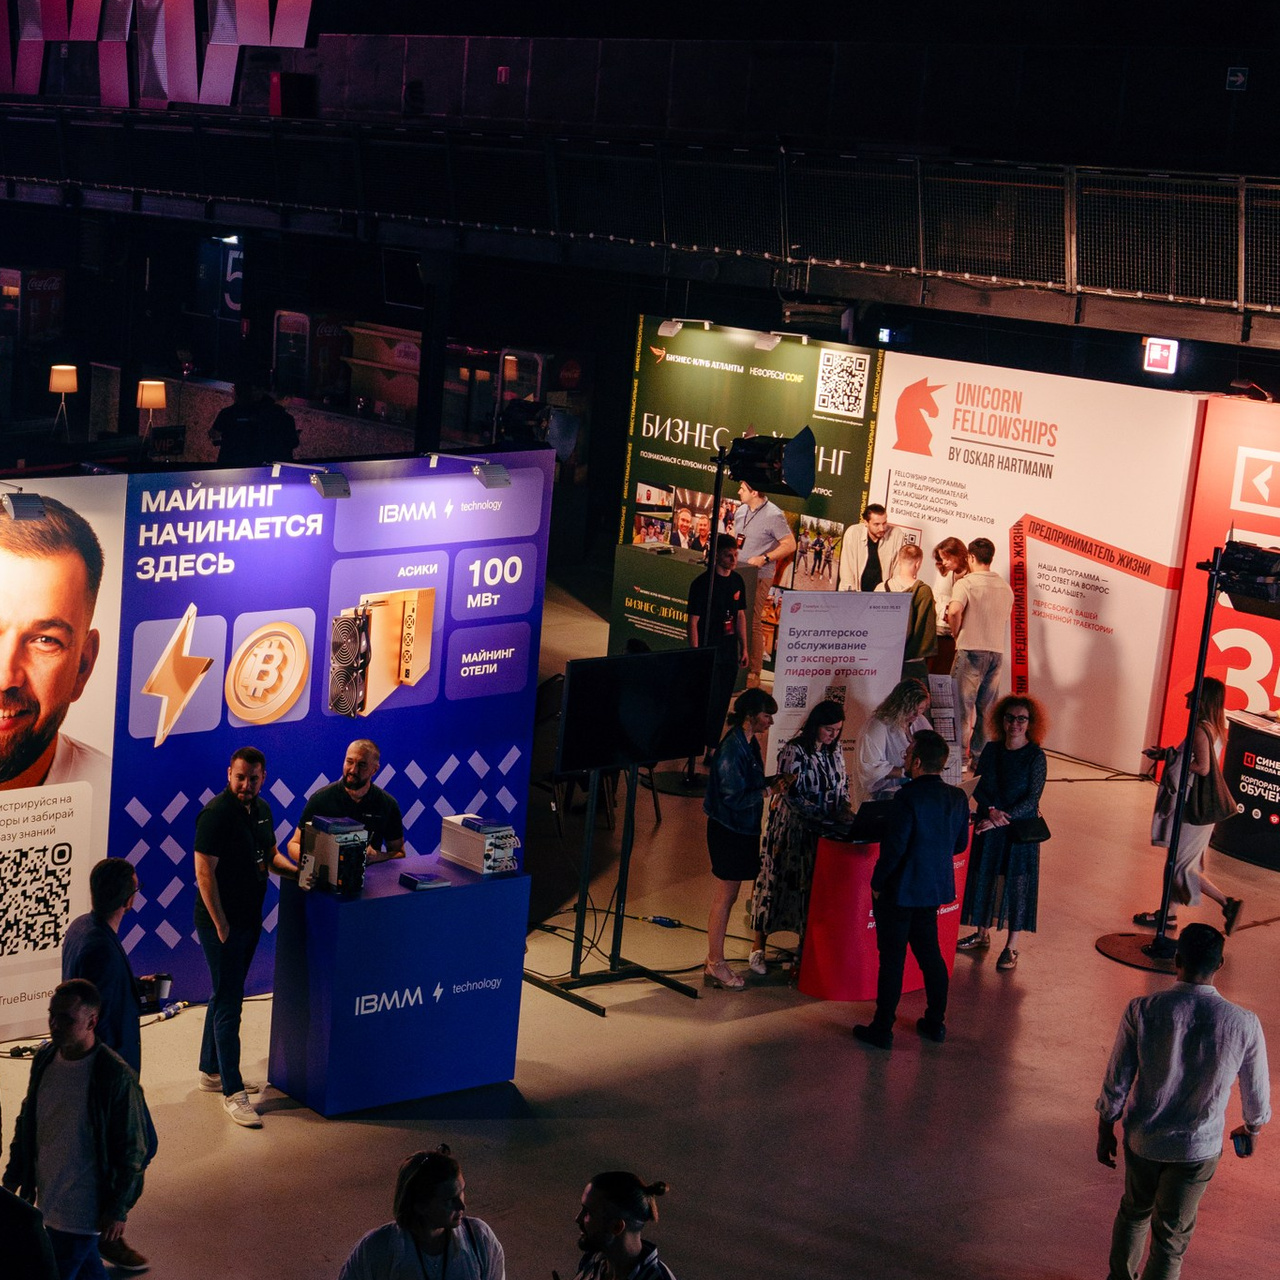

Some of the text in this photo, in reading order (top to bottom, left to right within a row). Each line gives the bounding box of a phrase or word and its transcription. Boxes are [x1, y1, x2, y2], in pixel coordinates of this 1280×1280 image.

[712, 361, 745, 374] АТЛАНТЫ
[955, 382, 1023, 415] UNICORN
[952, 408, 1058, 448] FELLOWSHIPS
[948, 446, 1054, 479] BY OSKAR HARTMANN
[141, 481, 282, 513] МАЙНИНГ
[378, 500, 503, 524] IBMM technology
[138, 513, 323, 547] НАЧИНАЕТСЯ
[1028, 520, 1152, 577] ПРЕДПРИНИМАТЕЛЬ ЖИЗНИ
[136, 552, 236, 582] ЗДЕСЬ
[397, 563, 438, 577] АСИКИ
[468, 555, 522, 587] 100
[1037, 563, 1100, 583] НАША ПРОГРАММА
[1013, 520, 1025, 666] ПРЕДПРИНИМАТЕЛЬ ЖИЗНИ
[1037, 573, 1110, 595] ЭТО ОТВЕТ НА ВОПРОС
[466, 592, 500, 609] МВт
[1033, 599, 1098, 621] ПЕРЕСБОРКА ВАШЕЙ
[1031, 609, 1114, 635] ЖИЗНЕННОЙ ТРАЕКТОРИИ
[789, 627, 869, 640] Бухгалтерское
[461, 648, 515, 664] МАЙНИНГ
[787, 641, 867, 652] обслуживание
[460, 664, 498, 678] ОТЕЛИ
[786, 655, 856, 665] от экспертов
[784, 667, 878, 678] лидеров отрасли
[59, 795, 72, 804] на
[22, 815, 29, 824] и
[31, 808, 74, 824] забирай
[19, 825, 56, 840] знаний
[354, 978, 502, 1016] IBMM technology
